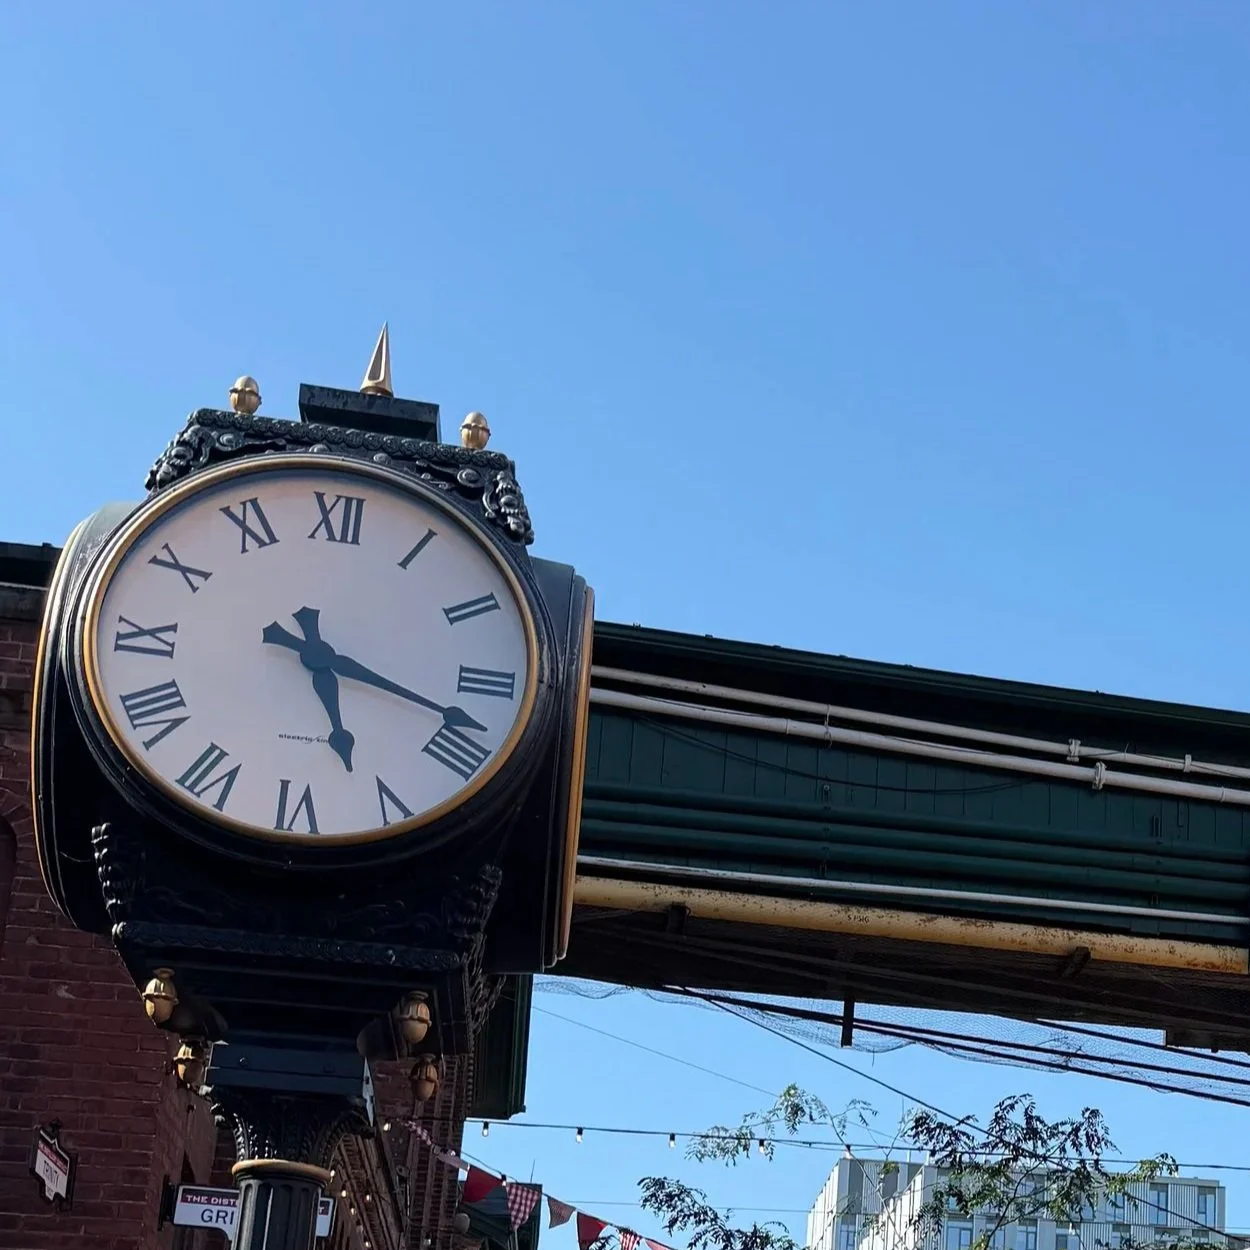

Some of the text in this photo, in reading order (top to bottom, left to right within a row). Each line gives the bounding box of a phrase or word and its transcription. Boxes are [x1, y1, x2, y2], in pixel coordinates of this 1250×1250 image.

[218, 497, 280, 554] XI
[307, 491, 366, 546] XII
[147, 543, 213, 593] X
[397, 528, 438, 570] I
[442, 592, 501, 626] II
[114, 615, 178, 659] IX
[457, 664, 515, 700] III
[119, 678, 191, 751] VIII
[175, 742, 242, 812] VII
[376, 774, 415, 826] V
[274, 778, 320, 834] VI
[185, 1194, 239, 1207] THE DIST
[201, 1208, 235, 1225] GRI
